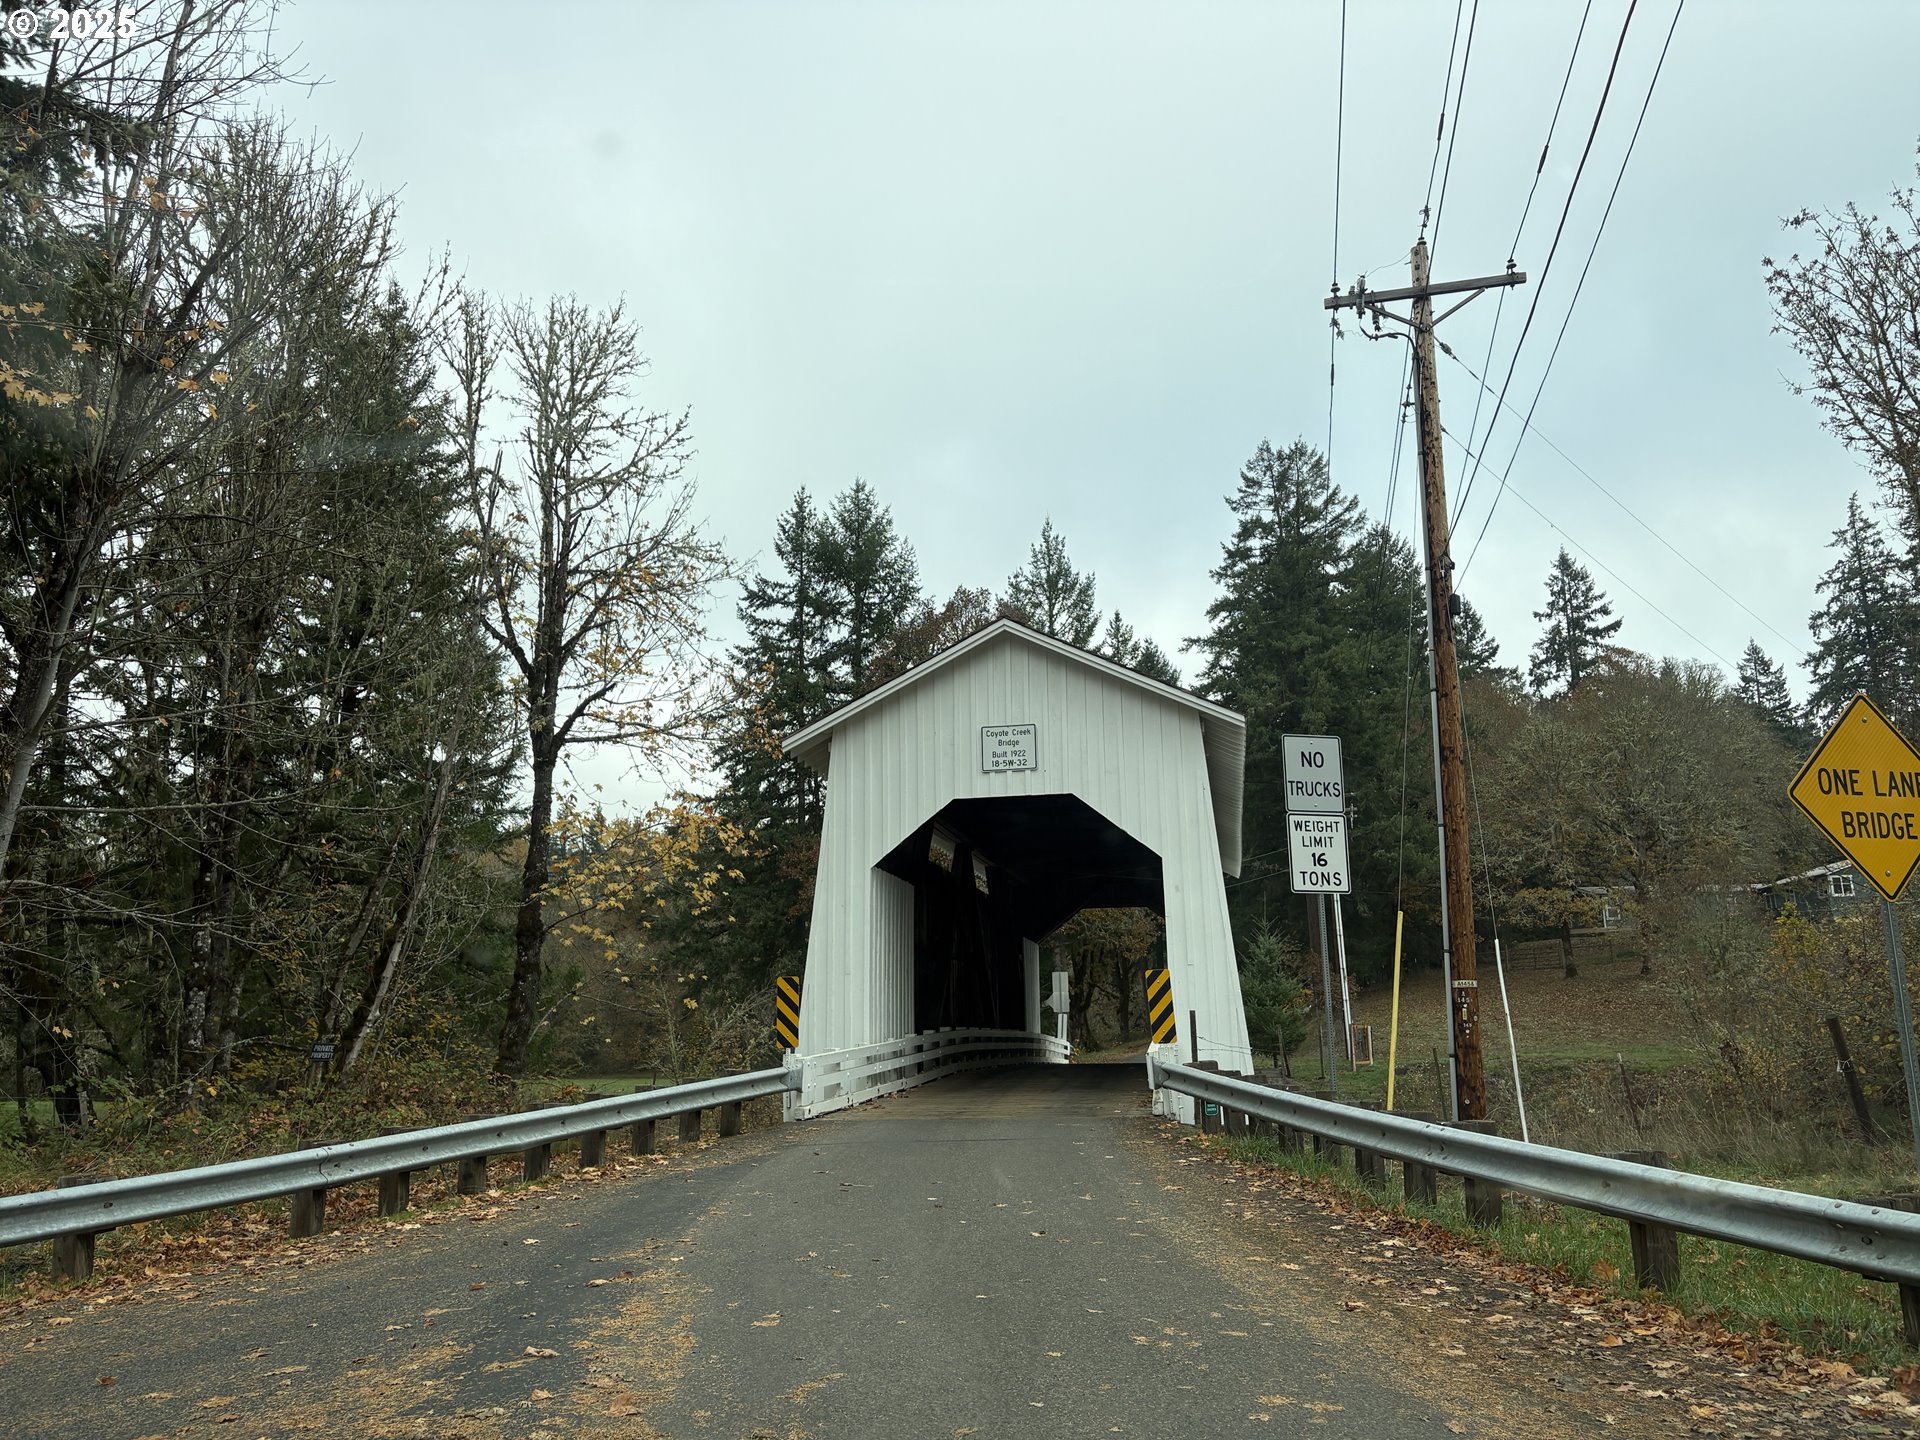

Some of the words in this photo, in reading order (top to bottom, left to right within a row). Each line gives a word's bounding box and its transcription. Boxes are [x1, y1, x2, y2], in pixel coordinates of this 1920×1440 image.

[986, 730, 1009, 738] Coyote
[1012, 728, 1031, 736] Creek
[998, 739, 1020, 747] Bridge
[1011, 749, 1026, 757] 1922
[1301, 751, 1324, 768] NO
[992, 759, 1027, 767] 18-5W-32
[1818, 767, 1863, 795] ONE
[1288, 780, 1341, 798] TRUCKS
[1294, 820, 1340, 833] WEIGHT
[1841, 811, 1918, 840] BRIDGE
[1302, 836, 1334, 848] LIMIT
[1311, 852, 1328, 867] 16
[1300, 871, 1342, 887] TONS
